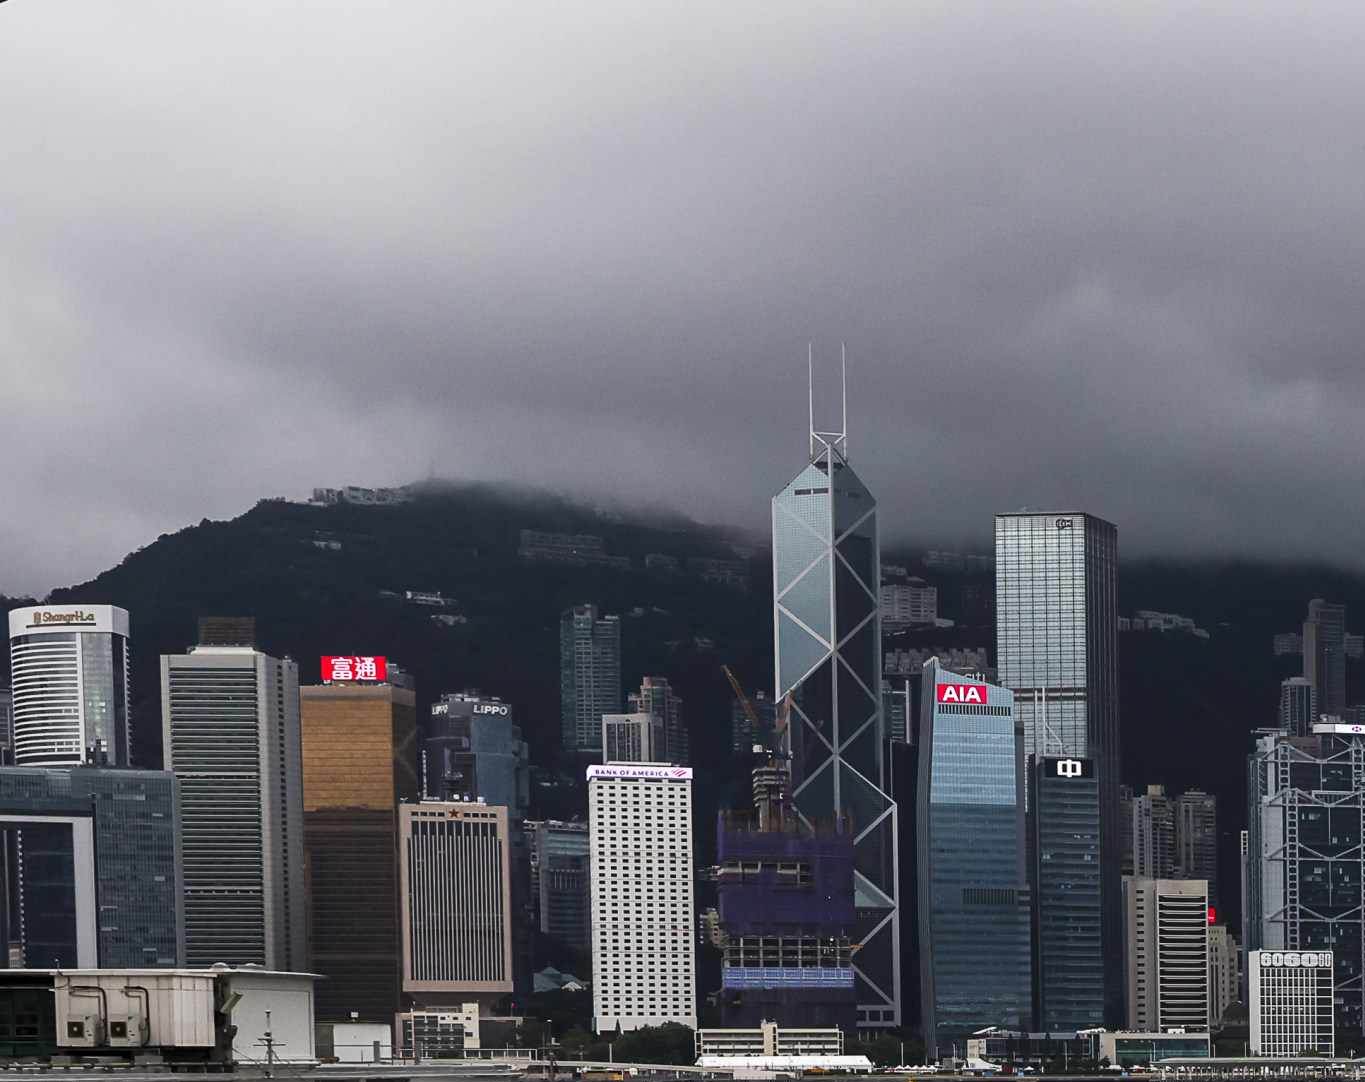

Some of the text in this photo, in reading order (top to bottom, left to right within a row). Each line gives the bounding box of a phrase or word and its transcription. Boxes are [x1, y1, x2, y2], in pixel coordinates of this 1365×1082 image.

[43, 611, 94, 623] Shangri-La
[331, 657, 377, 680] 富通
[943, 686, 981, 702] AIA
[432, 704, 448, 715] LIPPO
[473, 705, 507, 715] LIPPO
